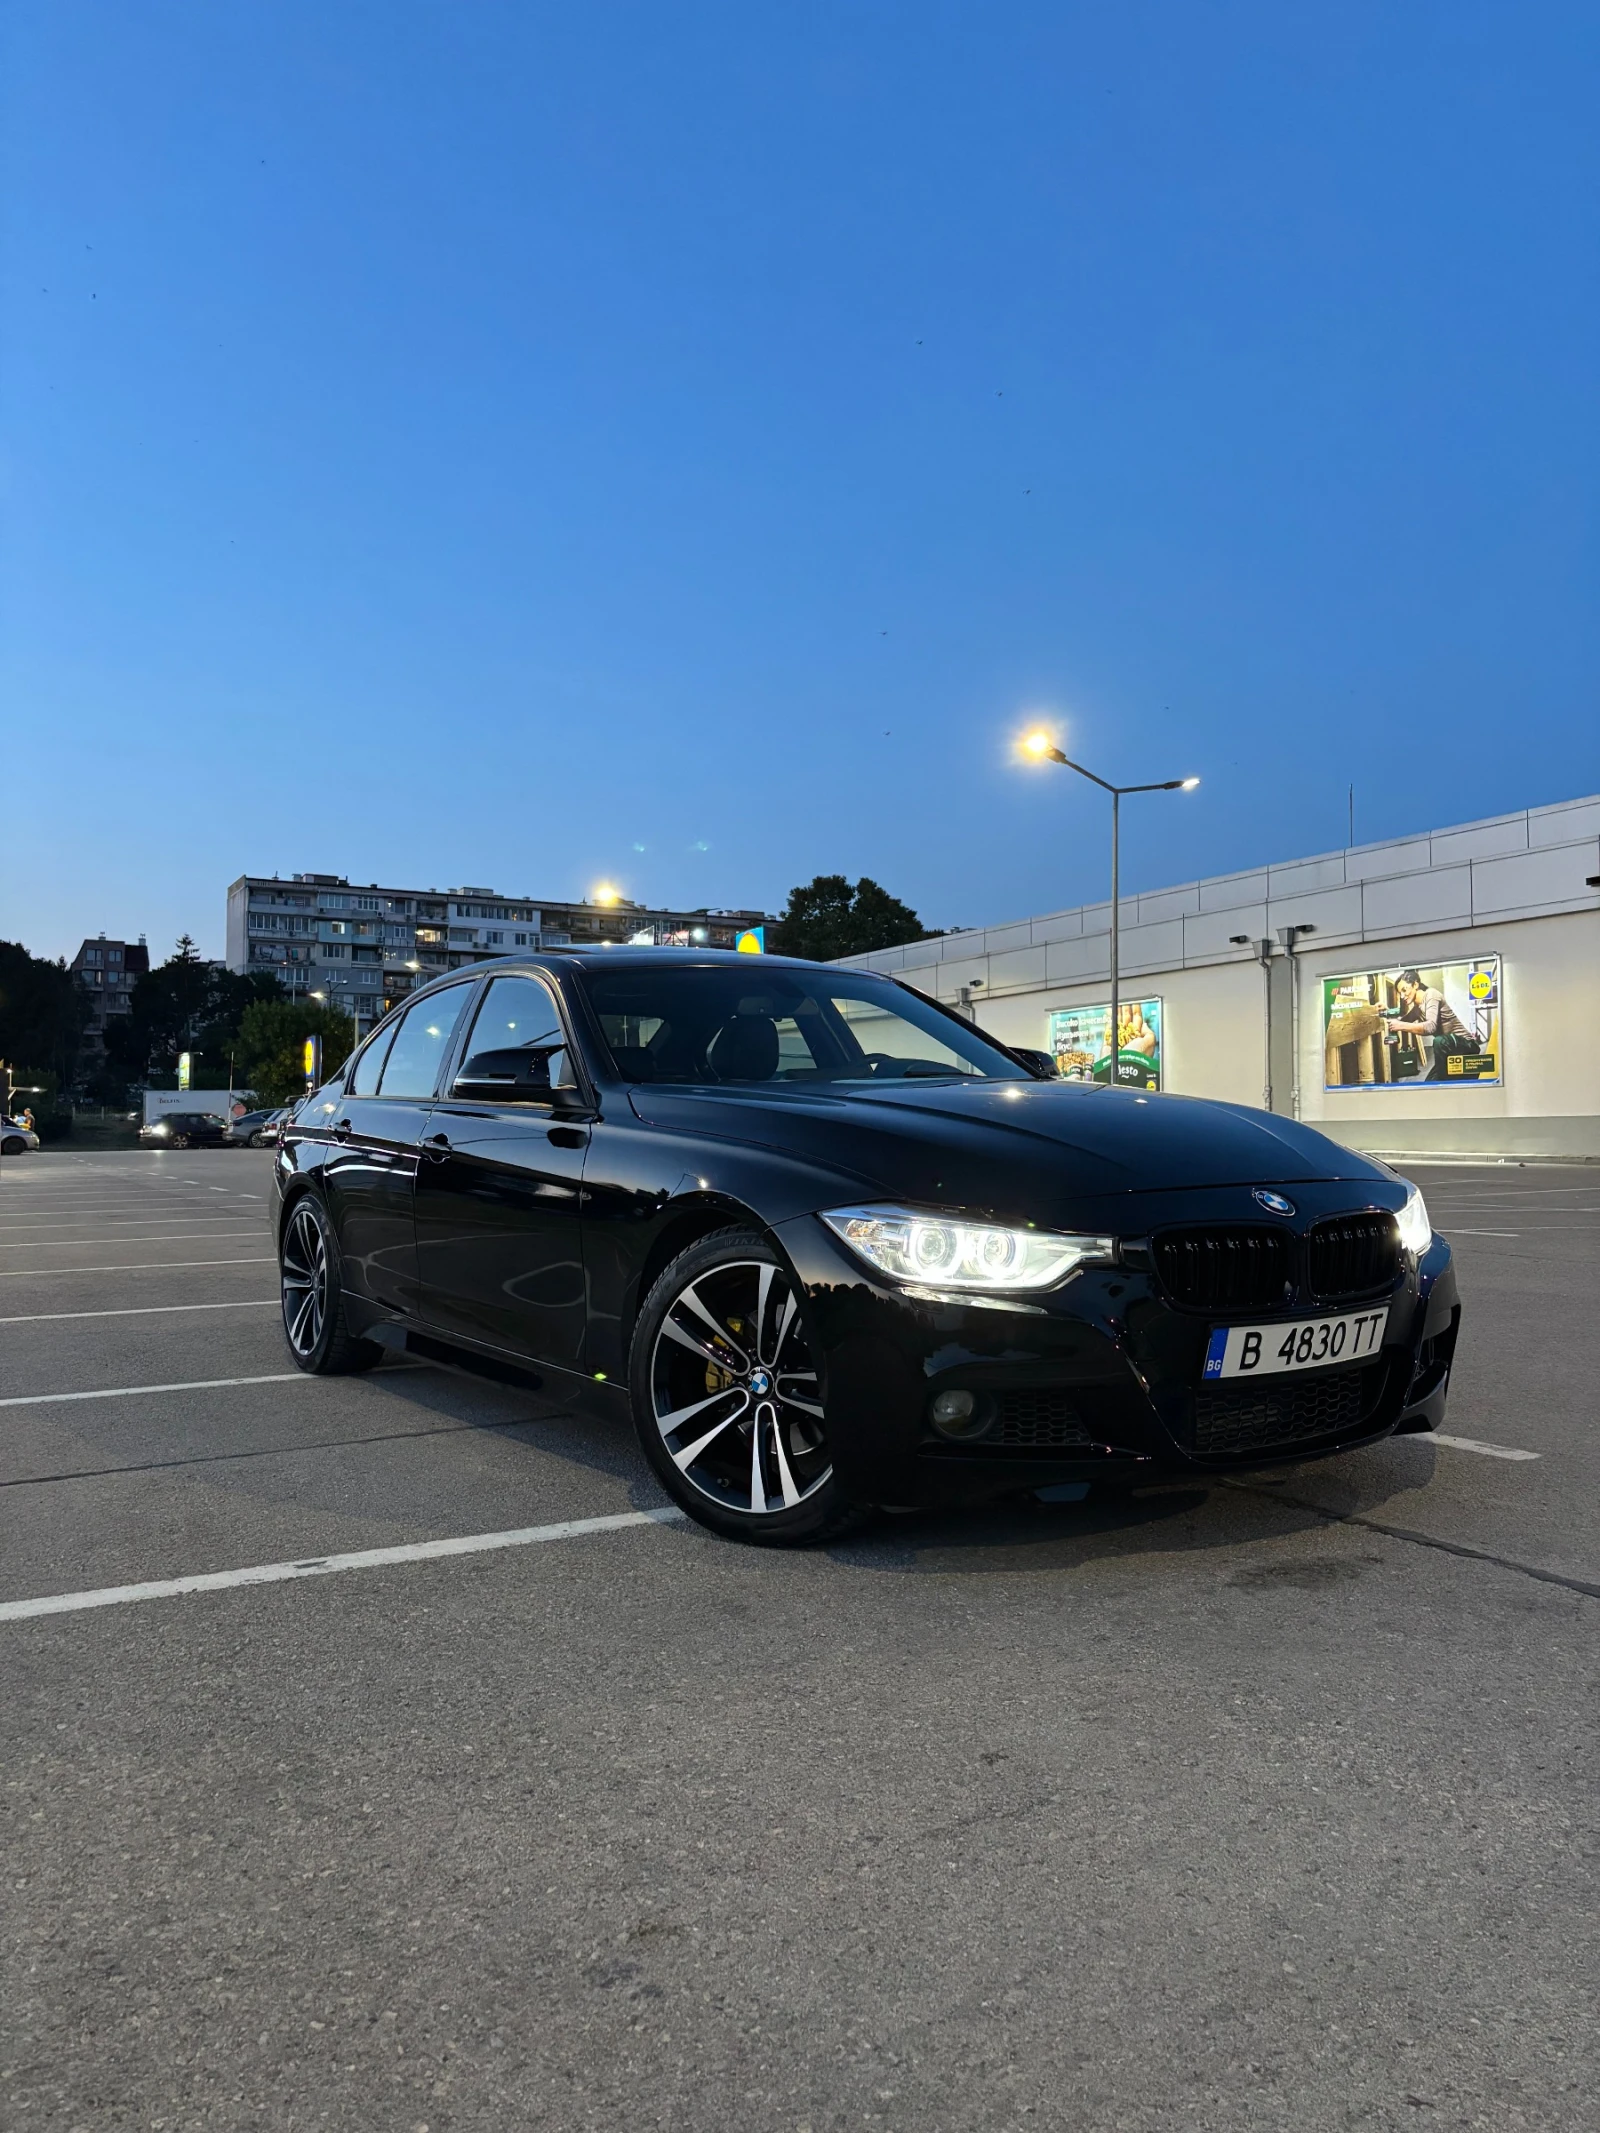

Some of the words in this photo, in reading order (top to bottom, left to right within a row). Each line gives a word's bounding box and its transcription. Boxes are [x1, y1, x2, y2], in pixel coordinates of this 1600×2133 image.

[1239, 1331, 1263, 1371] B
[1277, 1321, 1348, 1366] 4830
[1352, 1313, 1384, 1354] TT
[1206, 1359, 1222, 1372] BG
